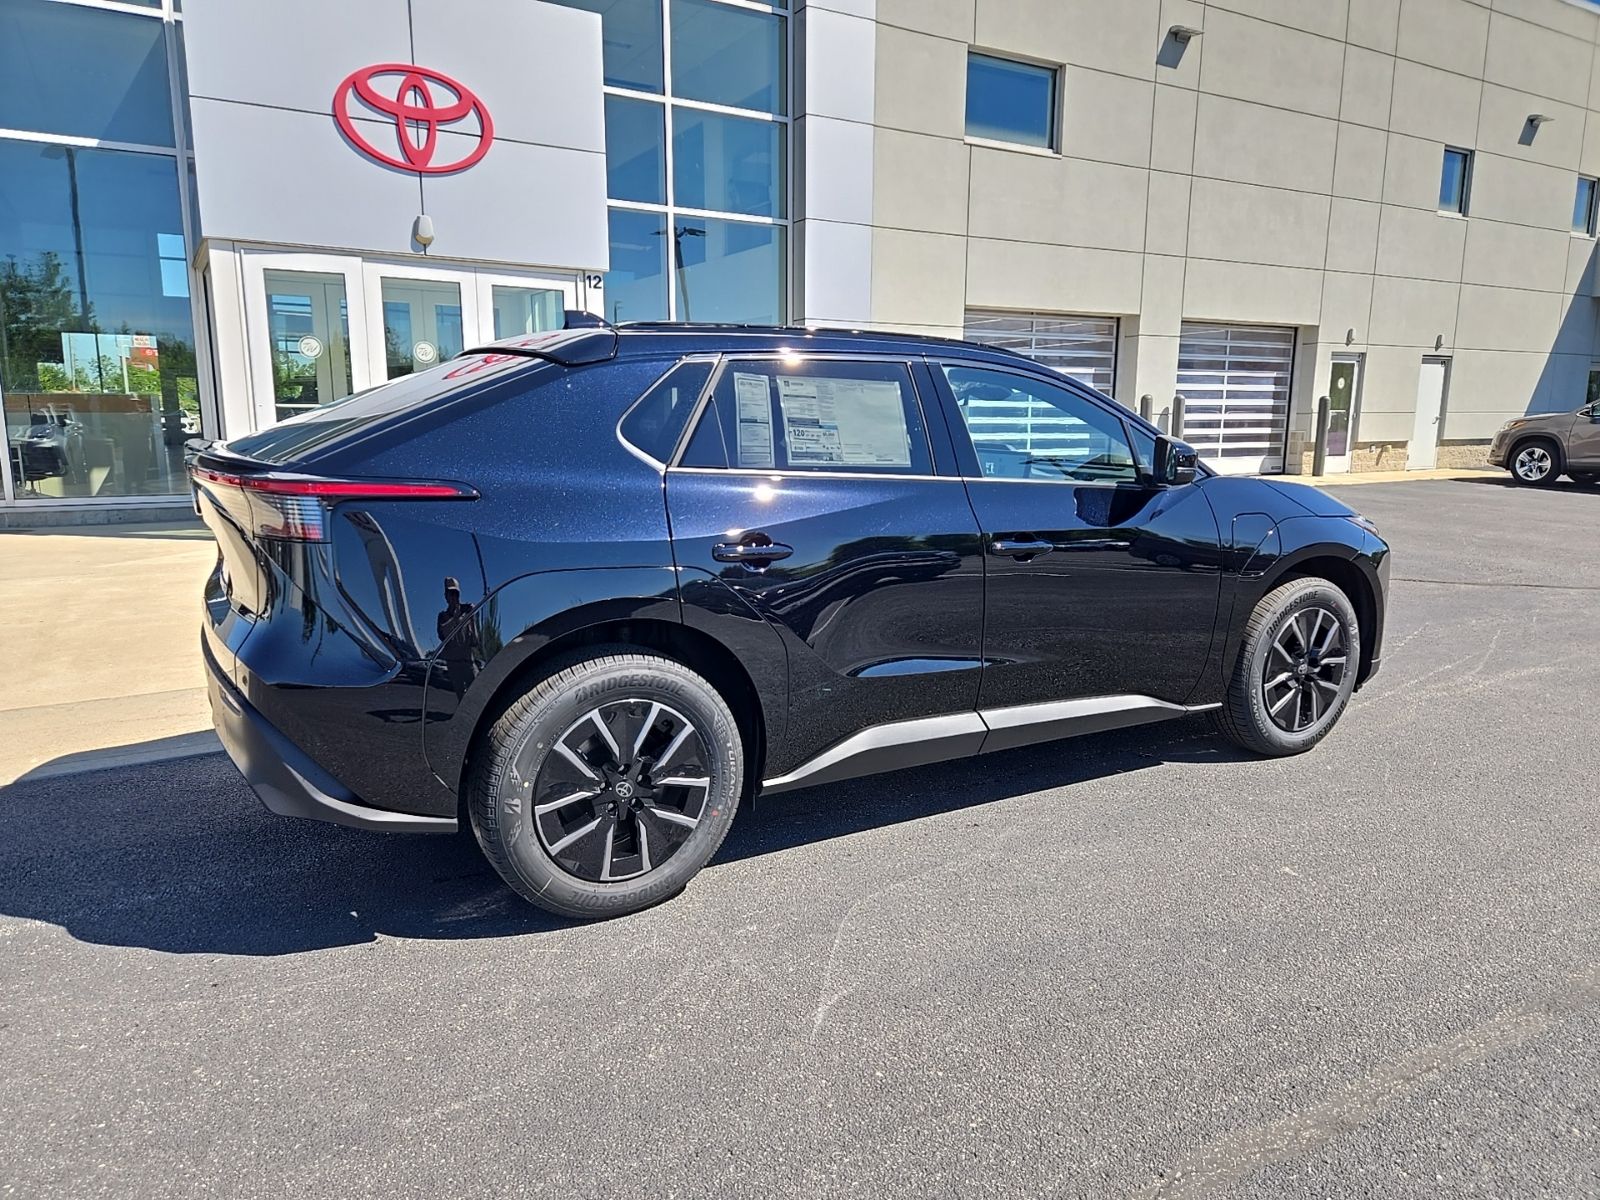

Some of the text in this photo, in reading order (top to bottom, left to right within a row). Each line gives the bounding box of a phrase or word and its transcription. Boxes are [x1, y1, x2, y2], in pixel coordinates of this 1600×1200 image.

[586, 274, 602, 289] 12
[793, 429, 805, 437] 120
[1265, 591, 1320, 640] BRIDGESTONE
[574, 673, 689, 705] BRIDGESTONE
[722, 740, 738, 820] TURANZA
